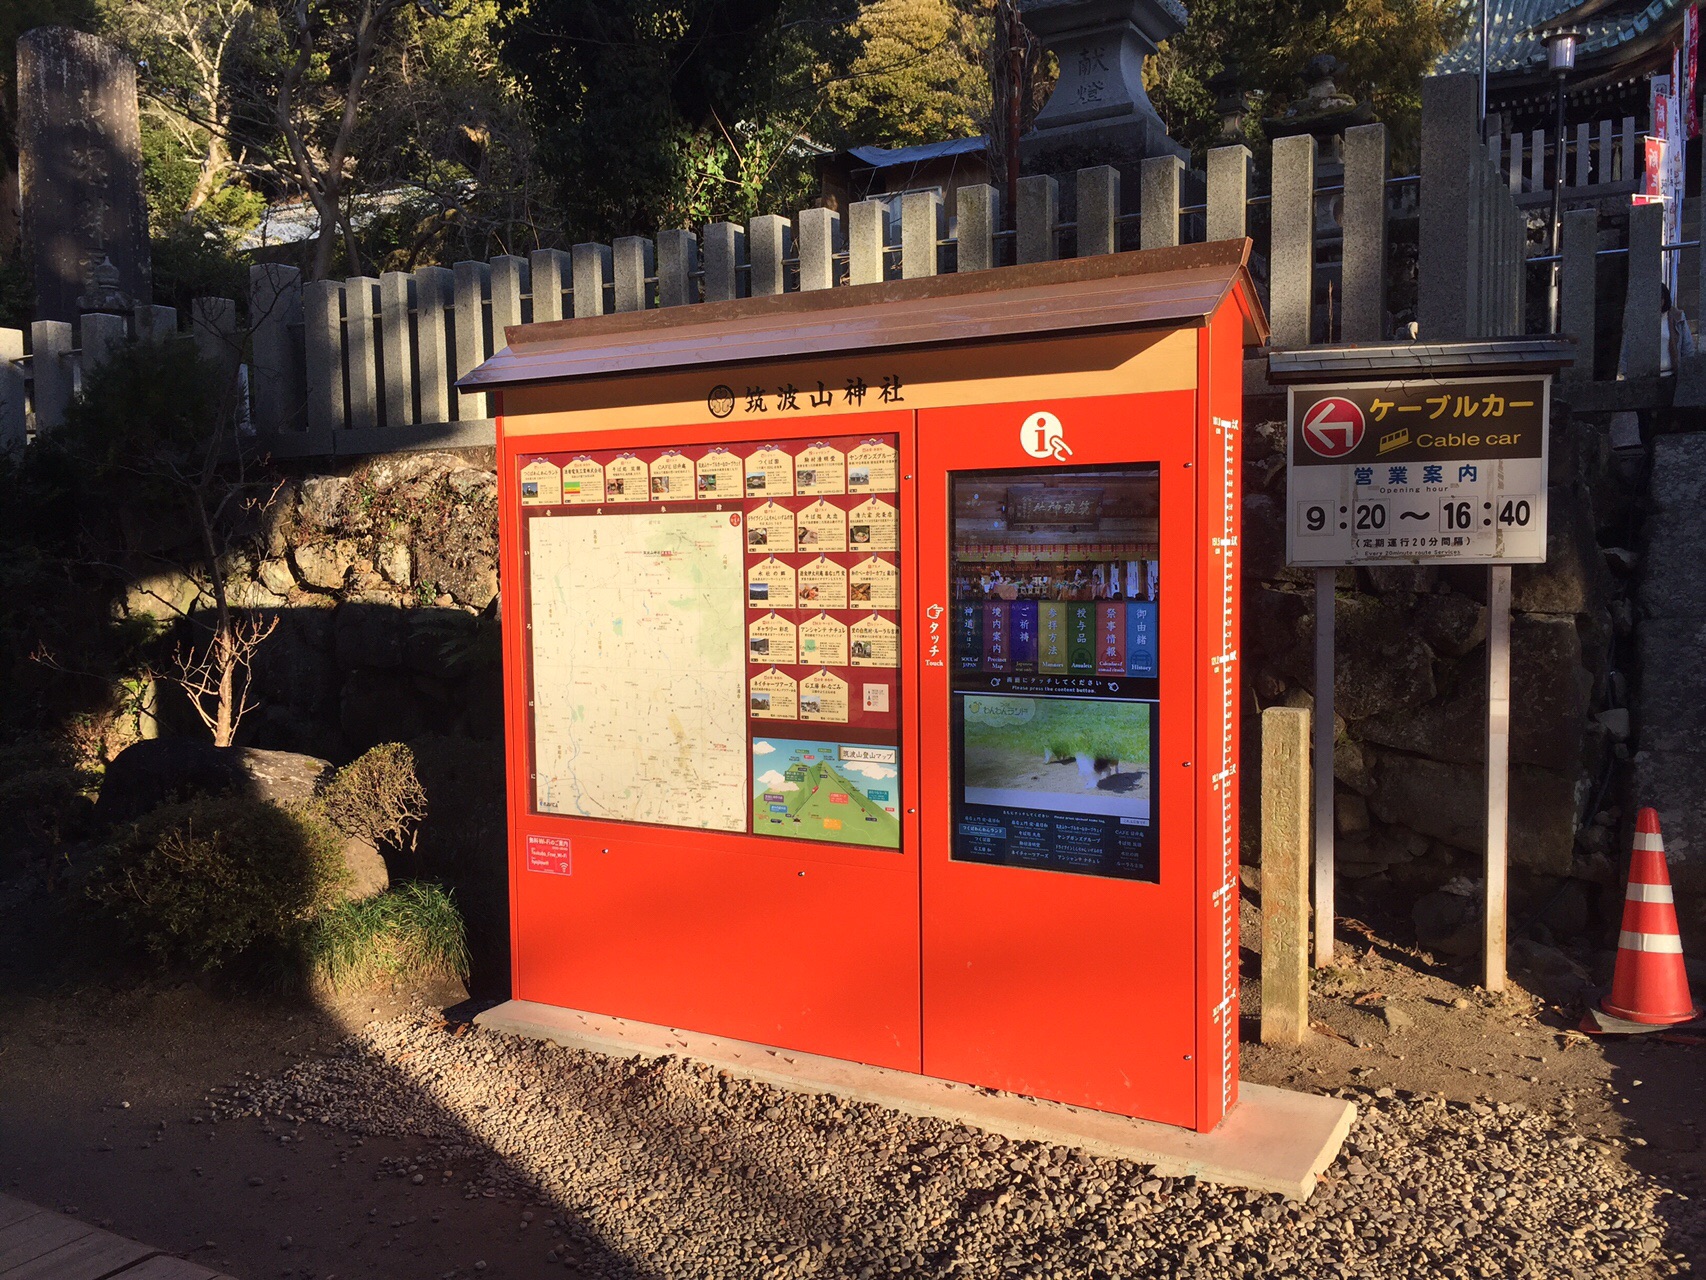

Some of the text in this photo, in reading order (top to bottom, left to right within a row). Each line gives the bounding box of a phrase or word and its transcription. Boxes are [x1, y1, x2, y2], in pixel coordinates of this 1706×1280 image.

[744, 375, 905, 414] 筑波山神社
[1369, 393, 1534, 421] ケーブルカー
[1416, 432, 1521, 448] Cable car
[1354, 464, 1478, 486] 営業案内
[1379, 485, 1449, 495] Opening hour
[928, 621, 940, 657] タッチ
[991, 607, 1002, 653] 境内案内
[1019, 607, 1029, 643] ご祈祷
[1048, 607, 1058, 656] 参拝方法
[1077, 608, 1087, 644] 授与品
[1106, 608, 1117, 656] 祭事情報
[1136, 609, 1147, 646] 御由緒
[924, 659, 944, 667] Touch
[992, 663, 1003, 671] Map
[1131, 664, 1152, 672] History
[843, 750, 895, 760] 筑波山登山マップ
